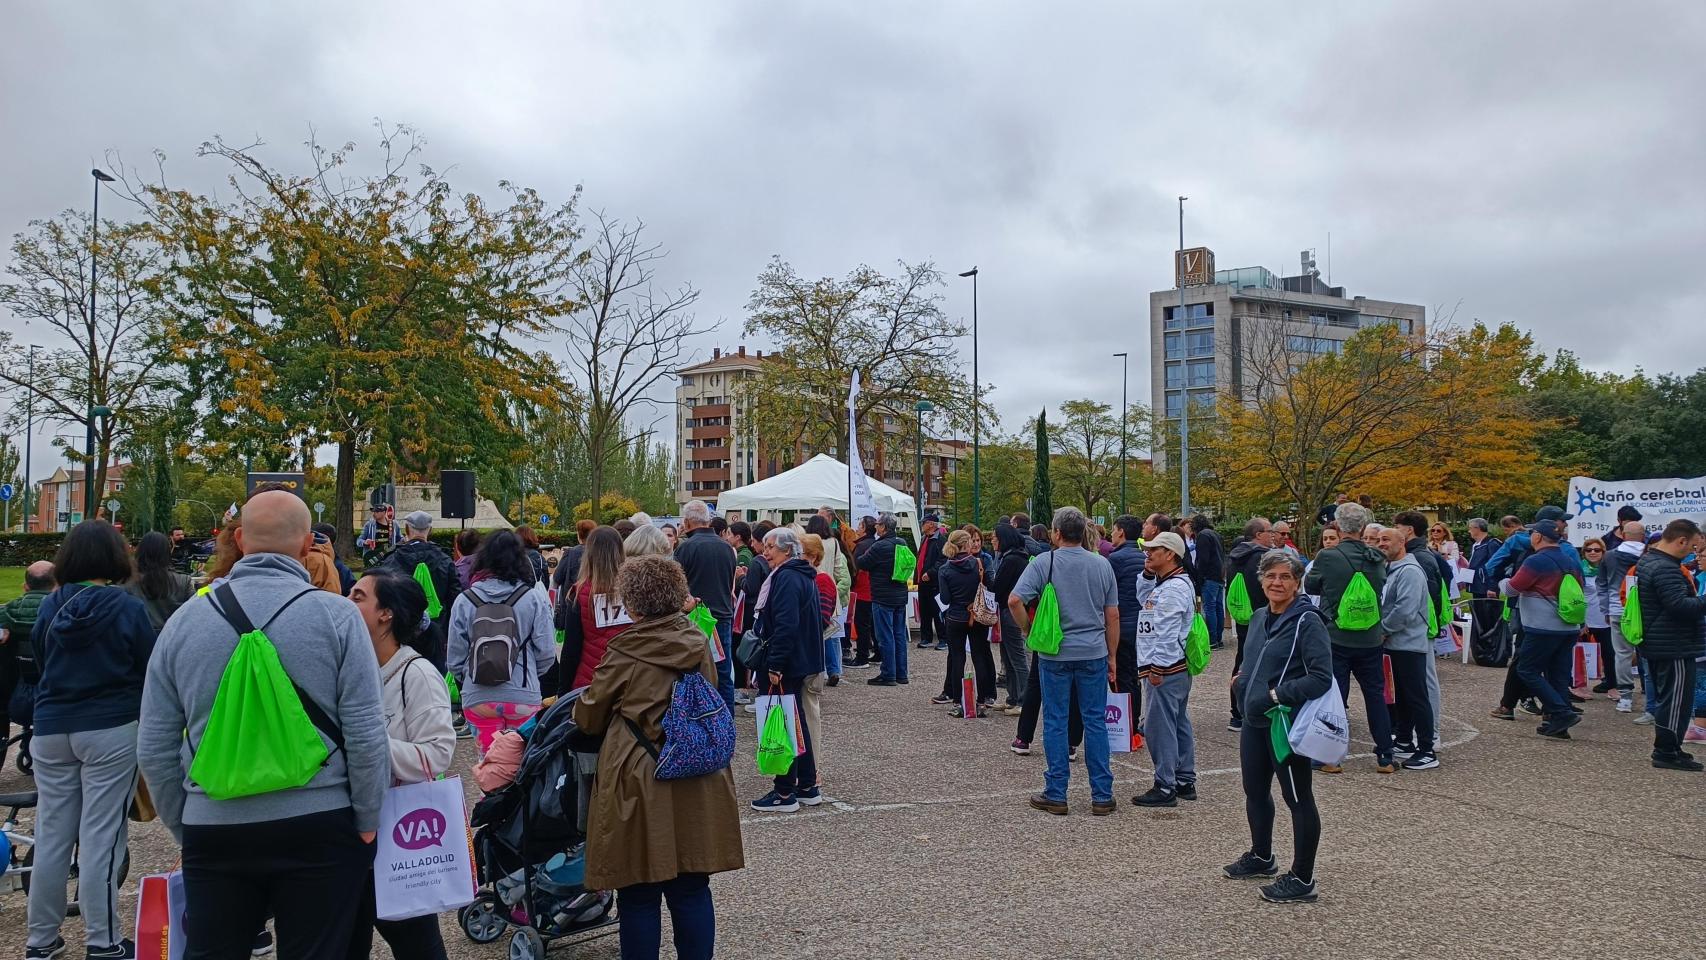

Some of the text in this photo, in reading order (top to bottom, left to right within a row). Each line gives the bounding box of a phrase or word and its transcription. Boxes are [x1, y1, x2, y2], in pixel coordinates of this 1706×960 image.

[1597, 486, 1706, 502] daño cerebral
[1577, 521, 1593, 530] 983
[1596, 523, 1610, 532] 157
[1645, 524, 1663, 532] 654
[602, 605, 628, 621] 17
[1138, 621, 1155, 634] 33
[398, 818, 440, 844] VA!
[391, 853, 455, 872] VALLADOLID
[388, 874, 408, 883] ciudad
[405, 878, 442, 889] friendly city
